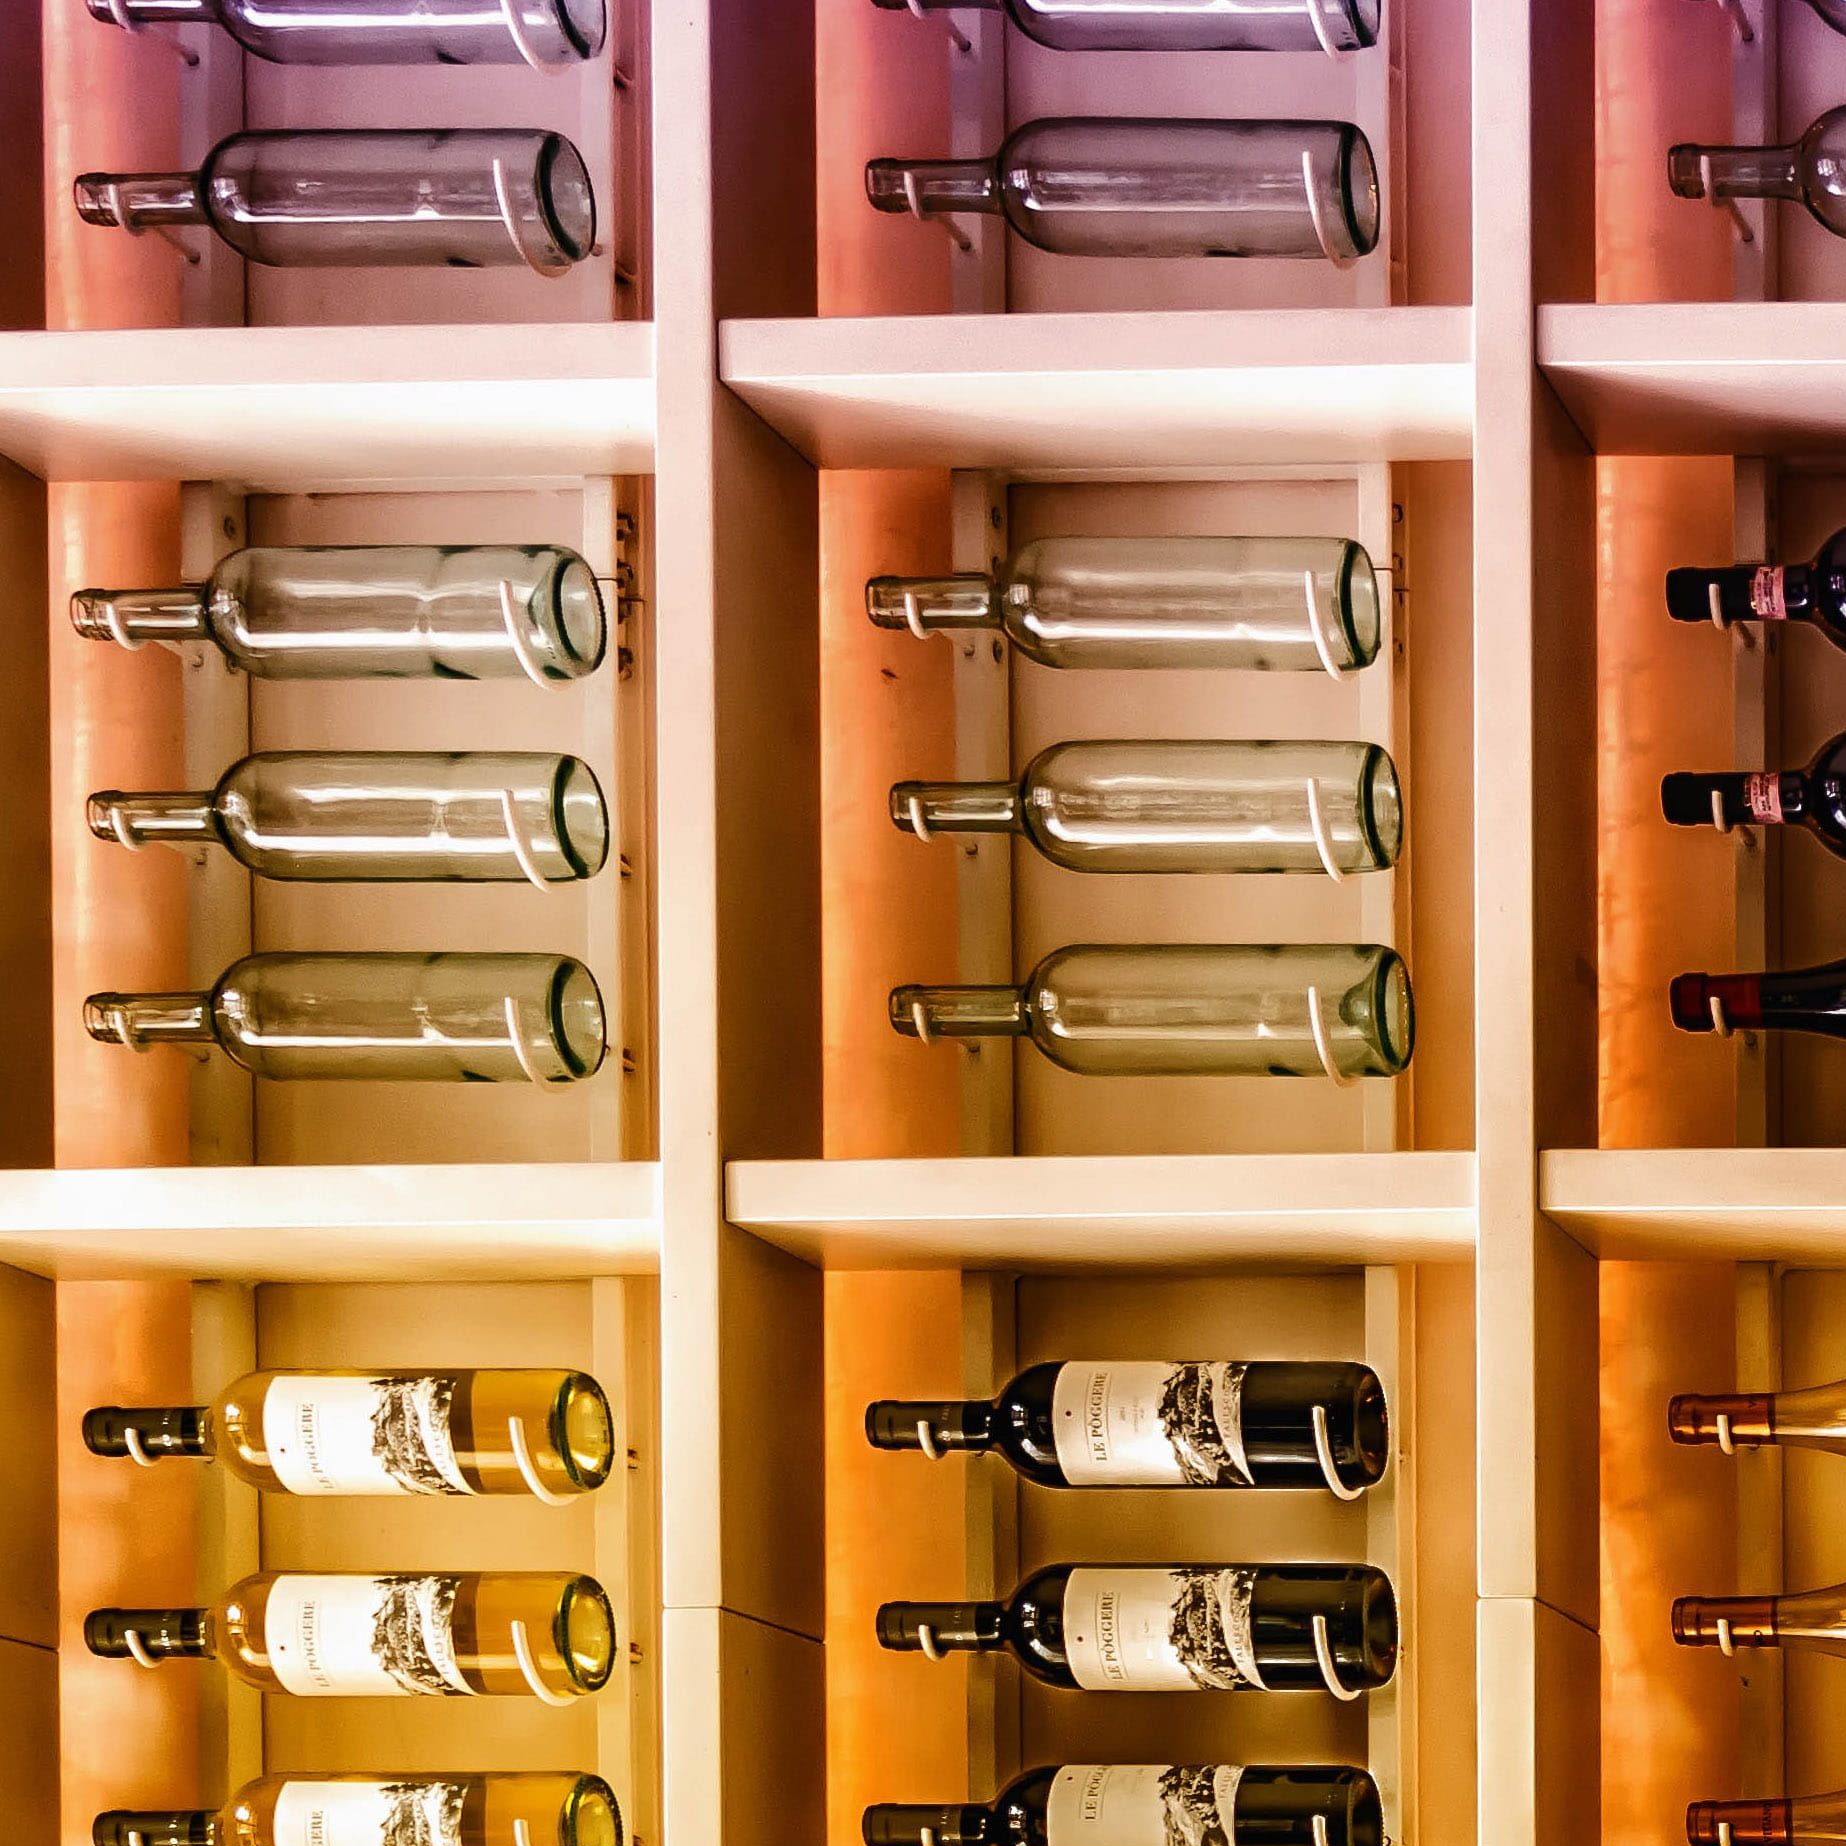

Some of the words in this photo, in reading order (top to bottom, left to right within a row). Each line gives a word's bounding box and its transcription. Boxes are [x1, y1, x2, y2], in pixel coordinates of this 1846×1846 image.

[1088, 1372, 1108, 1439] PÒGGERE
[1093, 1443, 1107, 1461] LE
[318, 1477, 333, 1489] LE
[1096, 1592, 1117, 1662] PÒGGERE
[314, 1672, 330, 1687] LE
[1106, 1665, 1123, 1680] LE
[1085, 1801, 1097, 1819] LE
